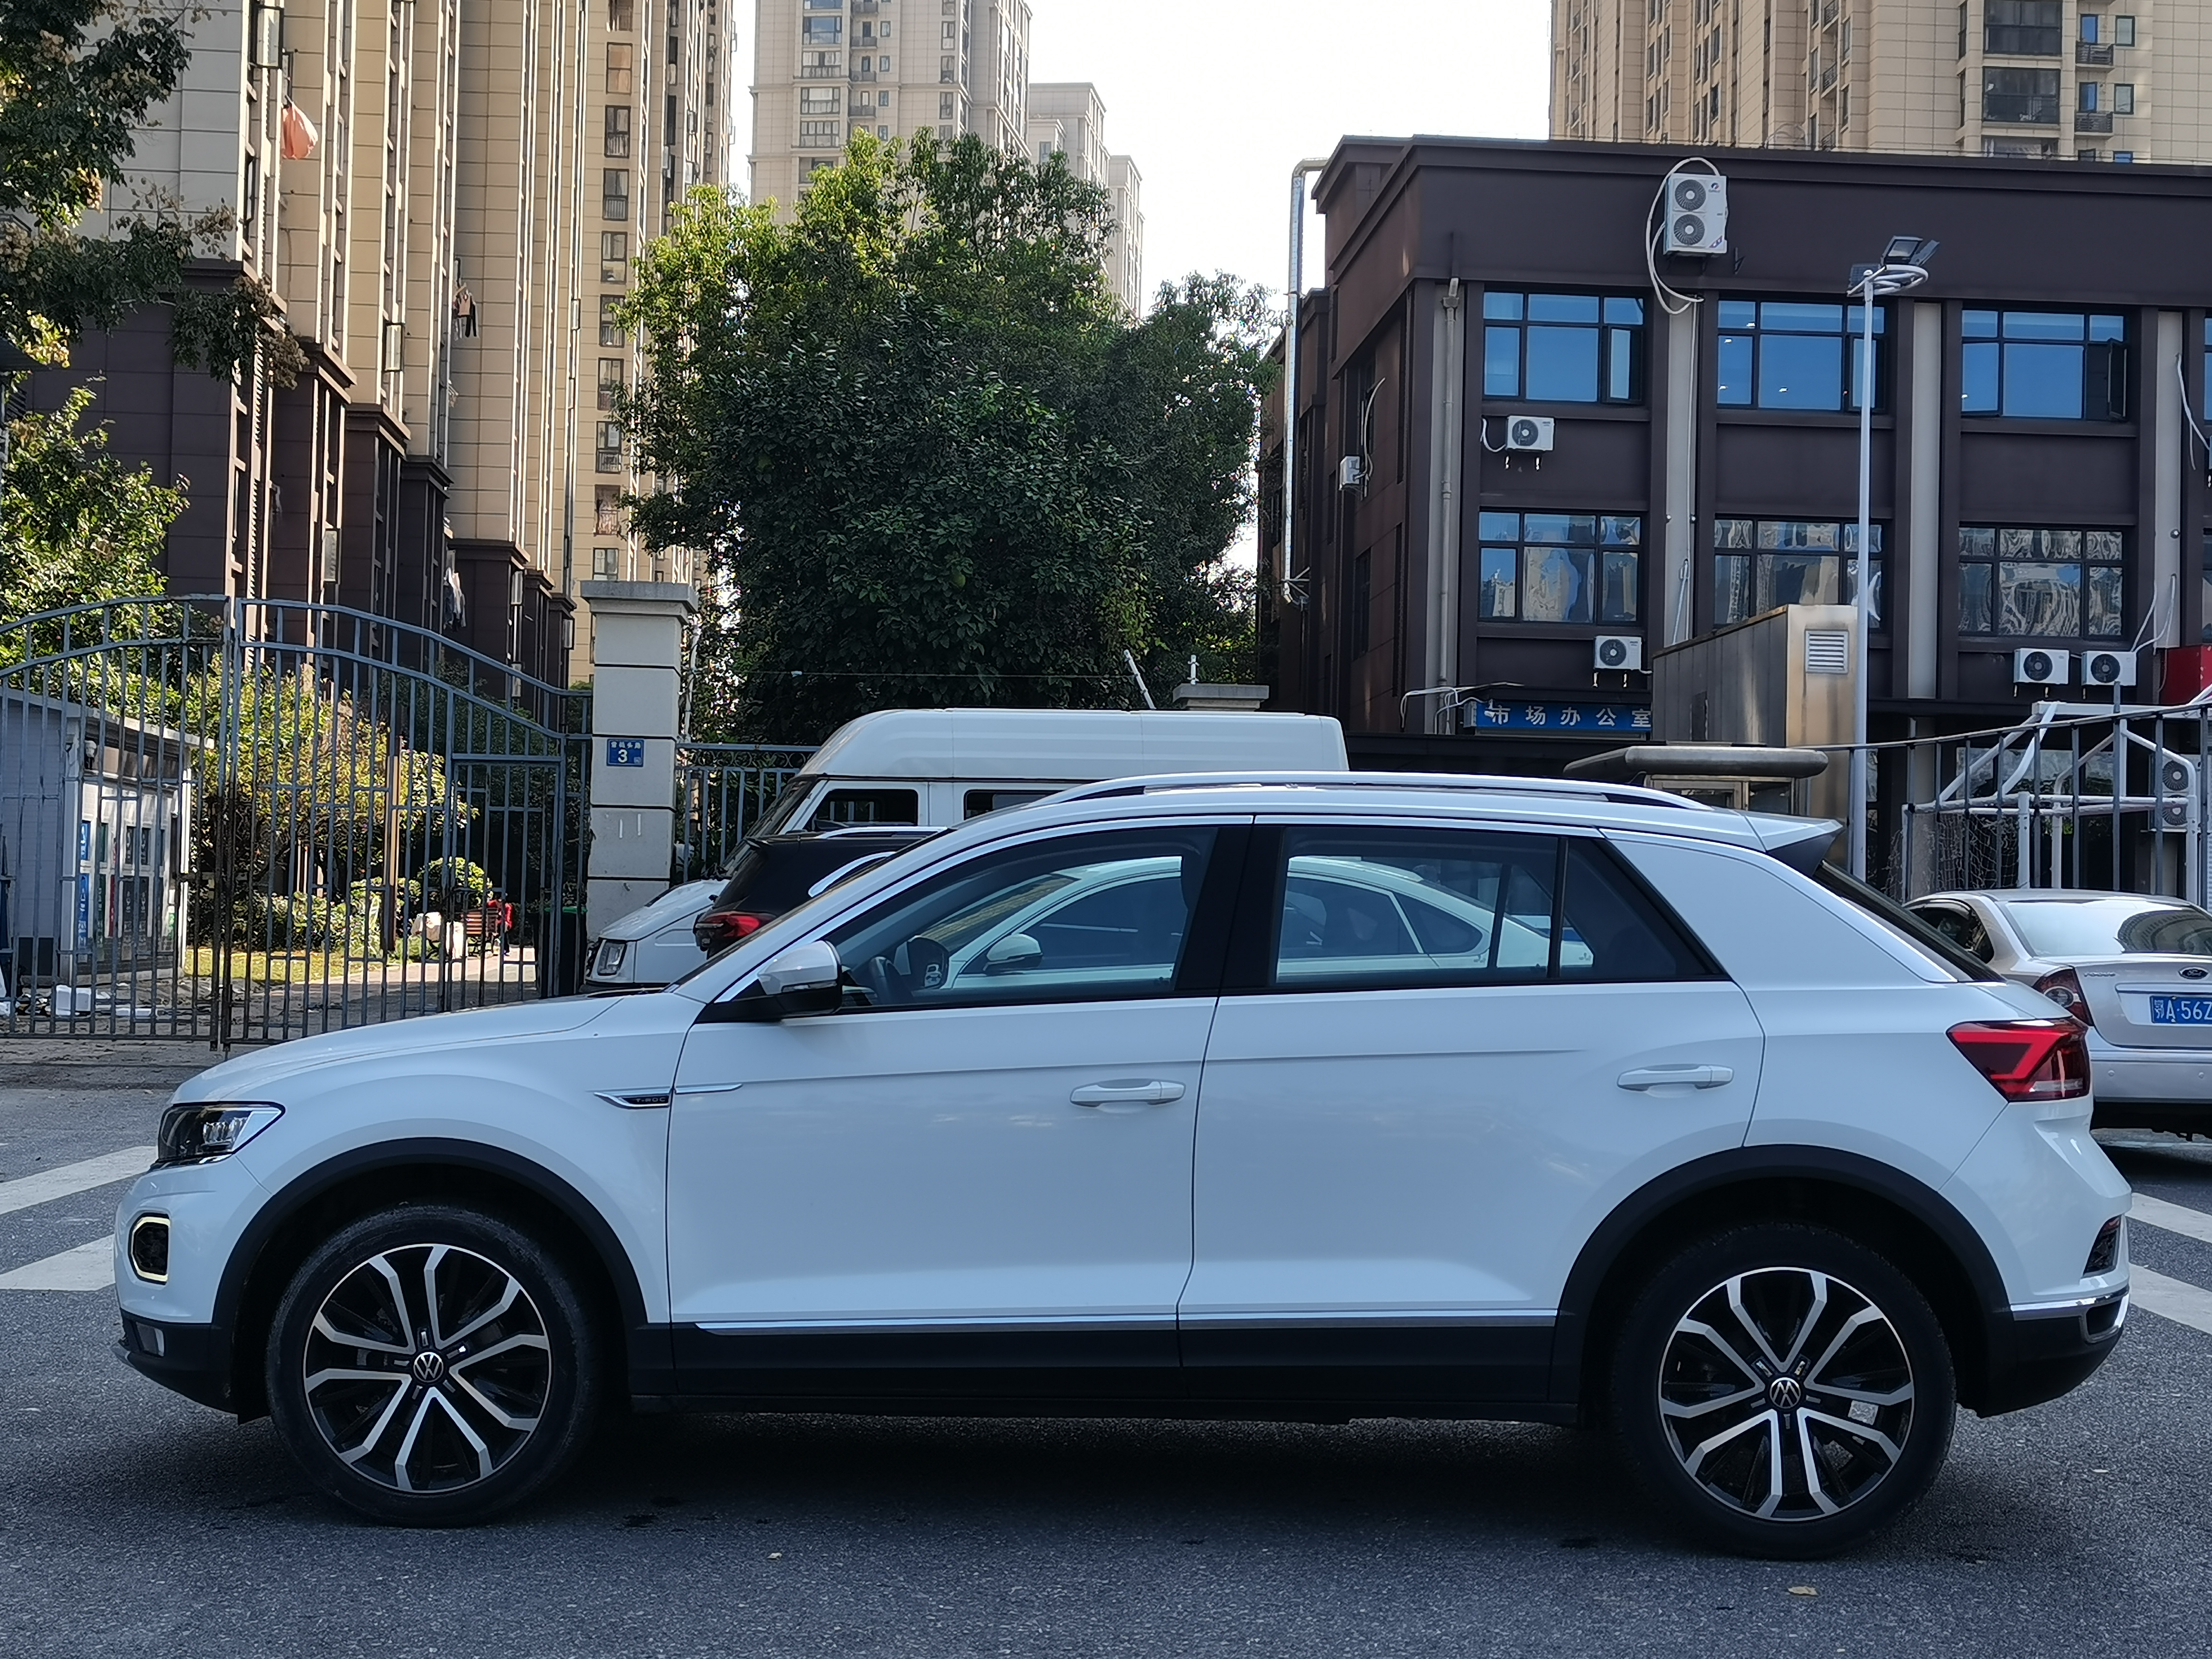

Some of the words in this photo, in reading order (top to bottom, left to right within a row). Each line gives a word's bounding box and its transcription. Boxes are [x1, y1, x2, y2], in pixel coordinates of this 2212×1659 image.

[1491, 705, 1651, 727] 市场办公室
[618, 749, 627, 763] 3
